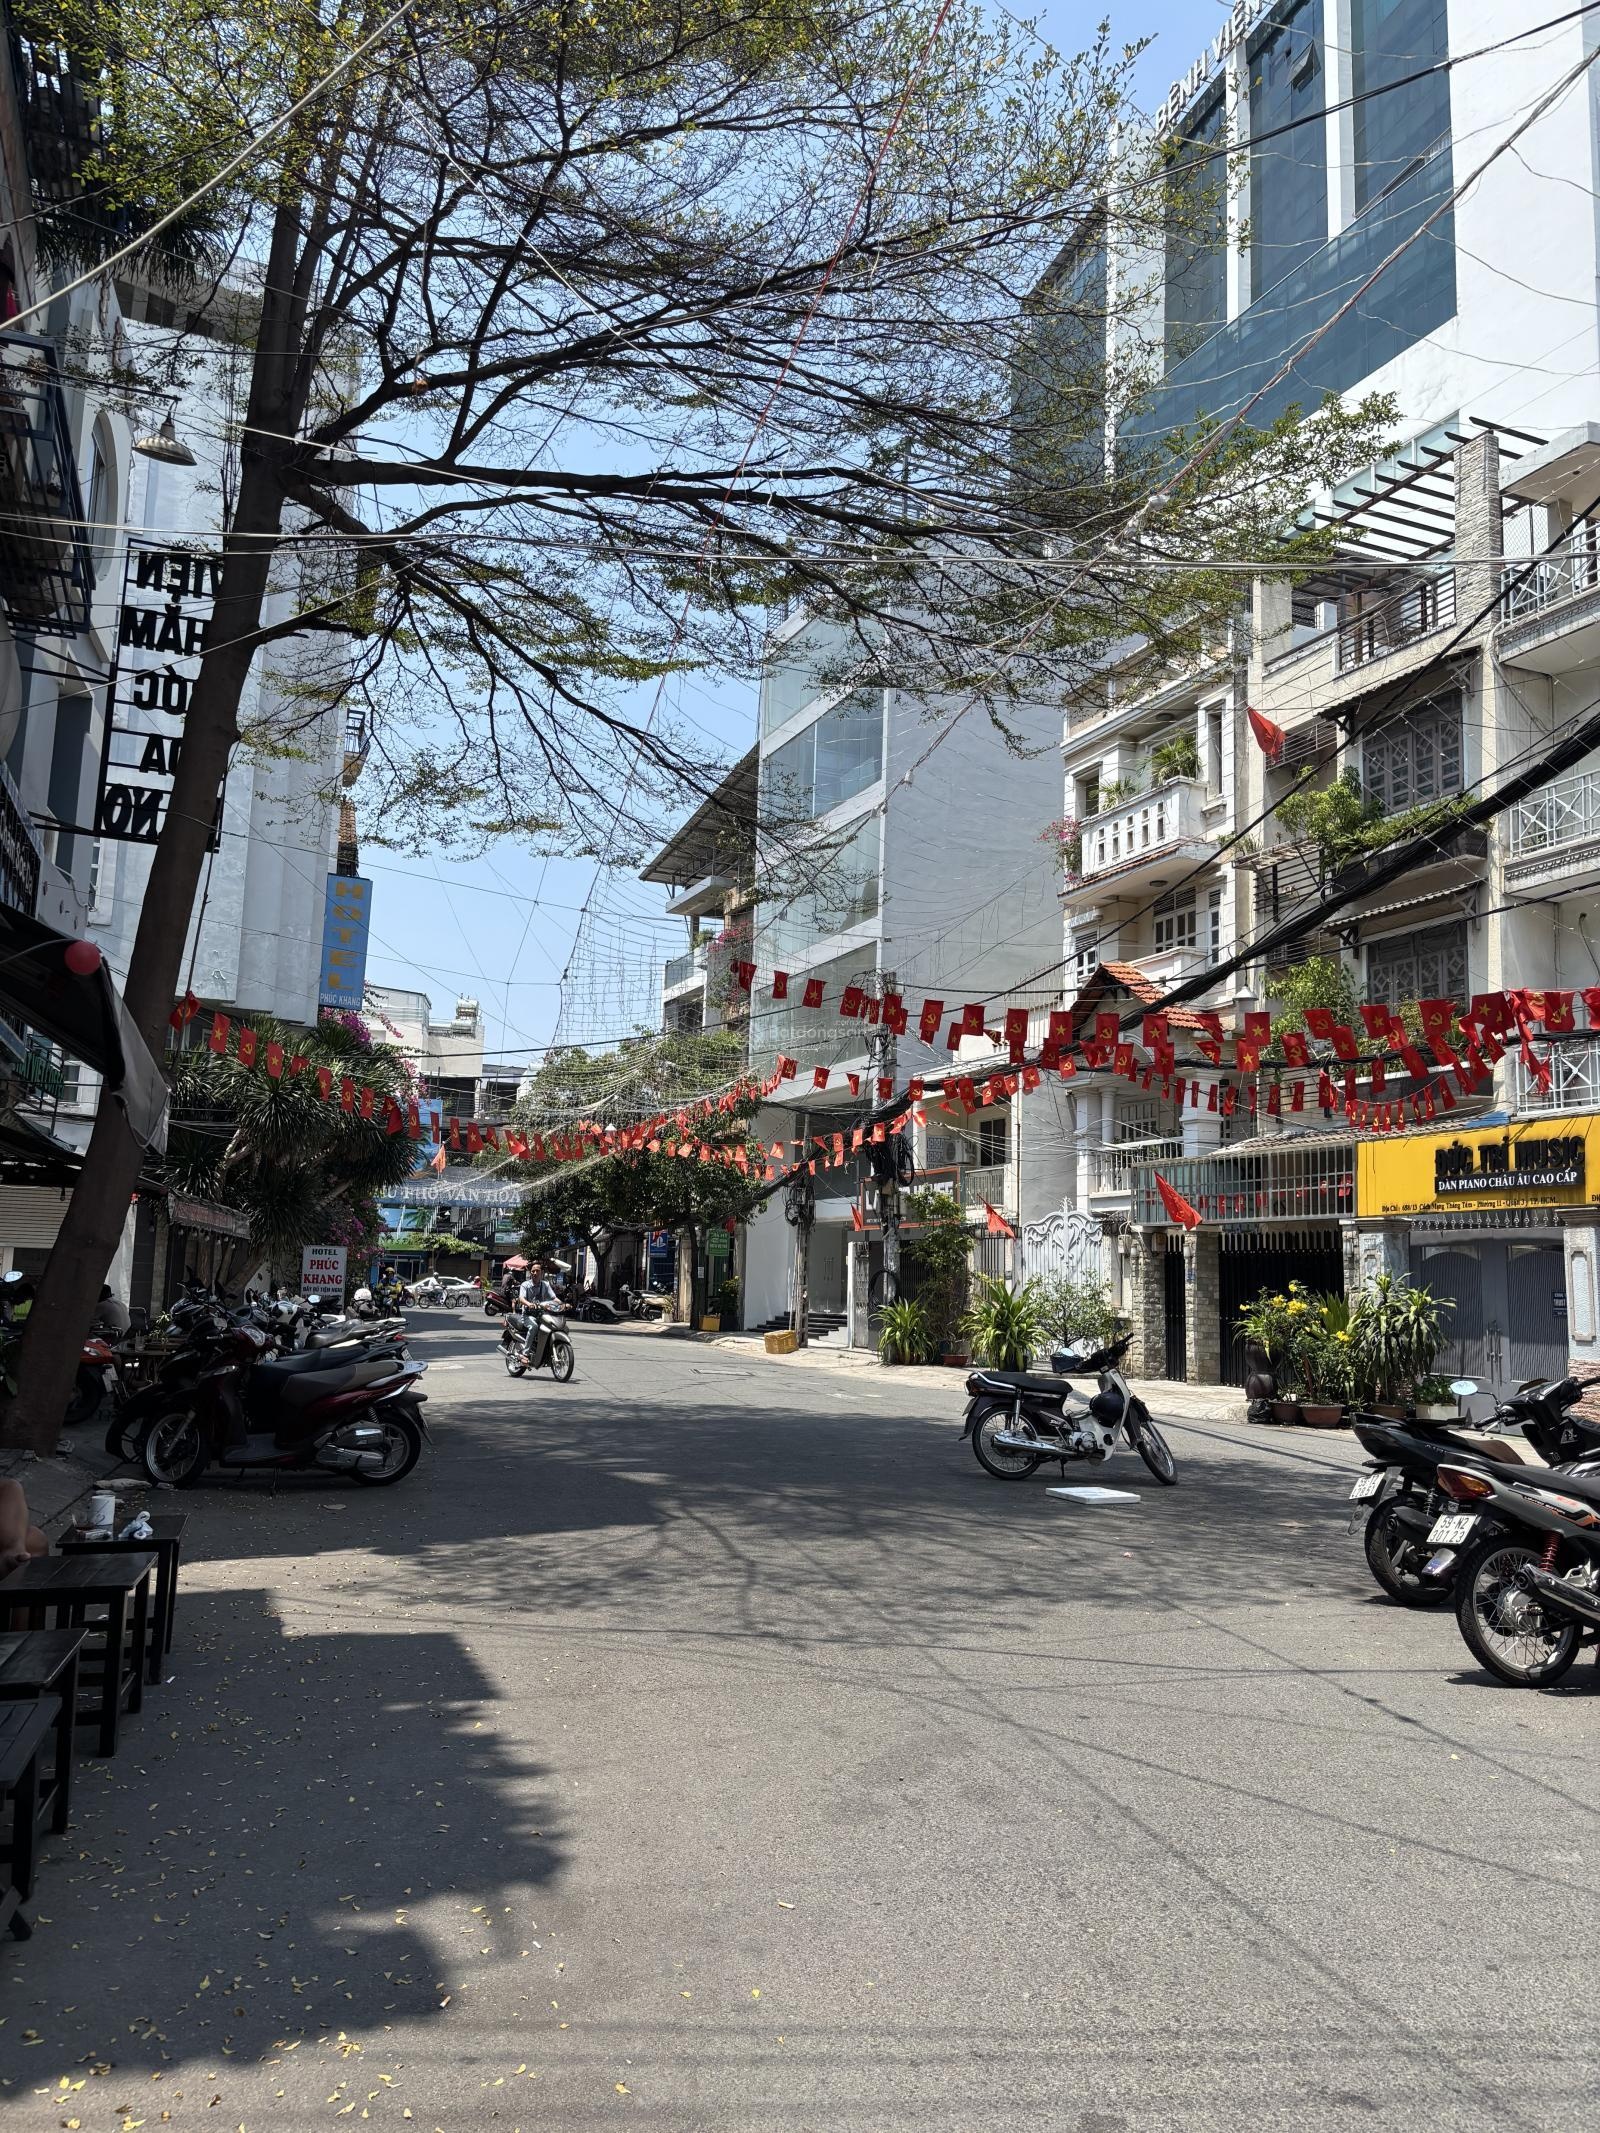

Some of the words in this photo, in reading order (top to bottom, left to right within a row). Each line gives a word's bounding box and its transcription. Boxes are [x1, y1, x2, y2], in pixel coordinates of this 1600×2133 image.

[327, 881, 364, 991] HOTEL
[320, 991, 337, 1004] PHÚC
[338, 995, 361, 1007] KHANG
[1514, 1136, 1586, 1171] MUSIC
[1459, 1177, 1487, 1189] PIANO
[1488, 1173, 1515, 1187] CHÂU
[1517, 1172, 1531, 1185] ÂU
[1532, 1173, 1554, 1185] CAO
[1556, 1167, 1578, 1183] CẤP
[312, 1248, 338, 1256] HOTEL
[310, 1257, 339, 1270] PHÚC
[303, 1273, 342, 1285] KHANG
